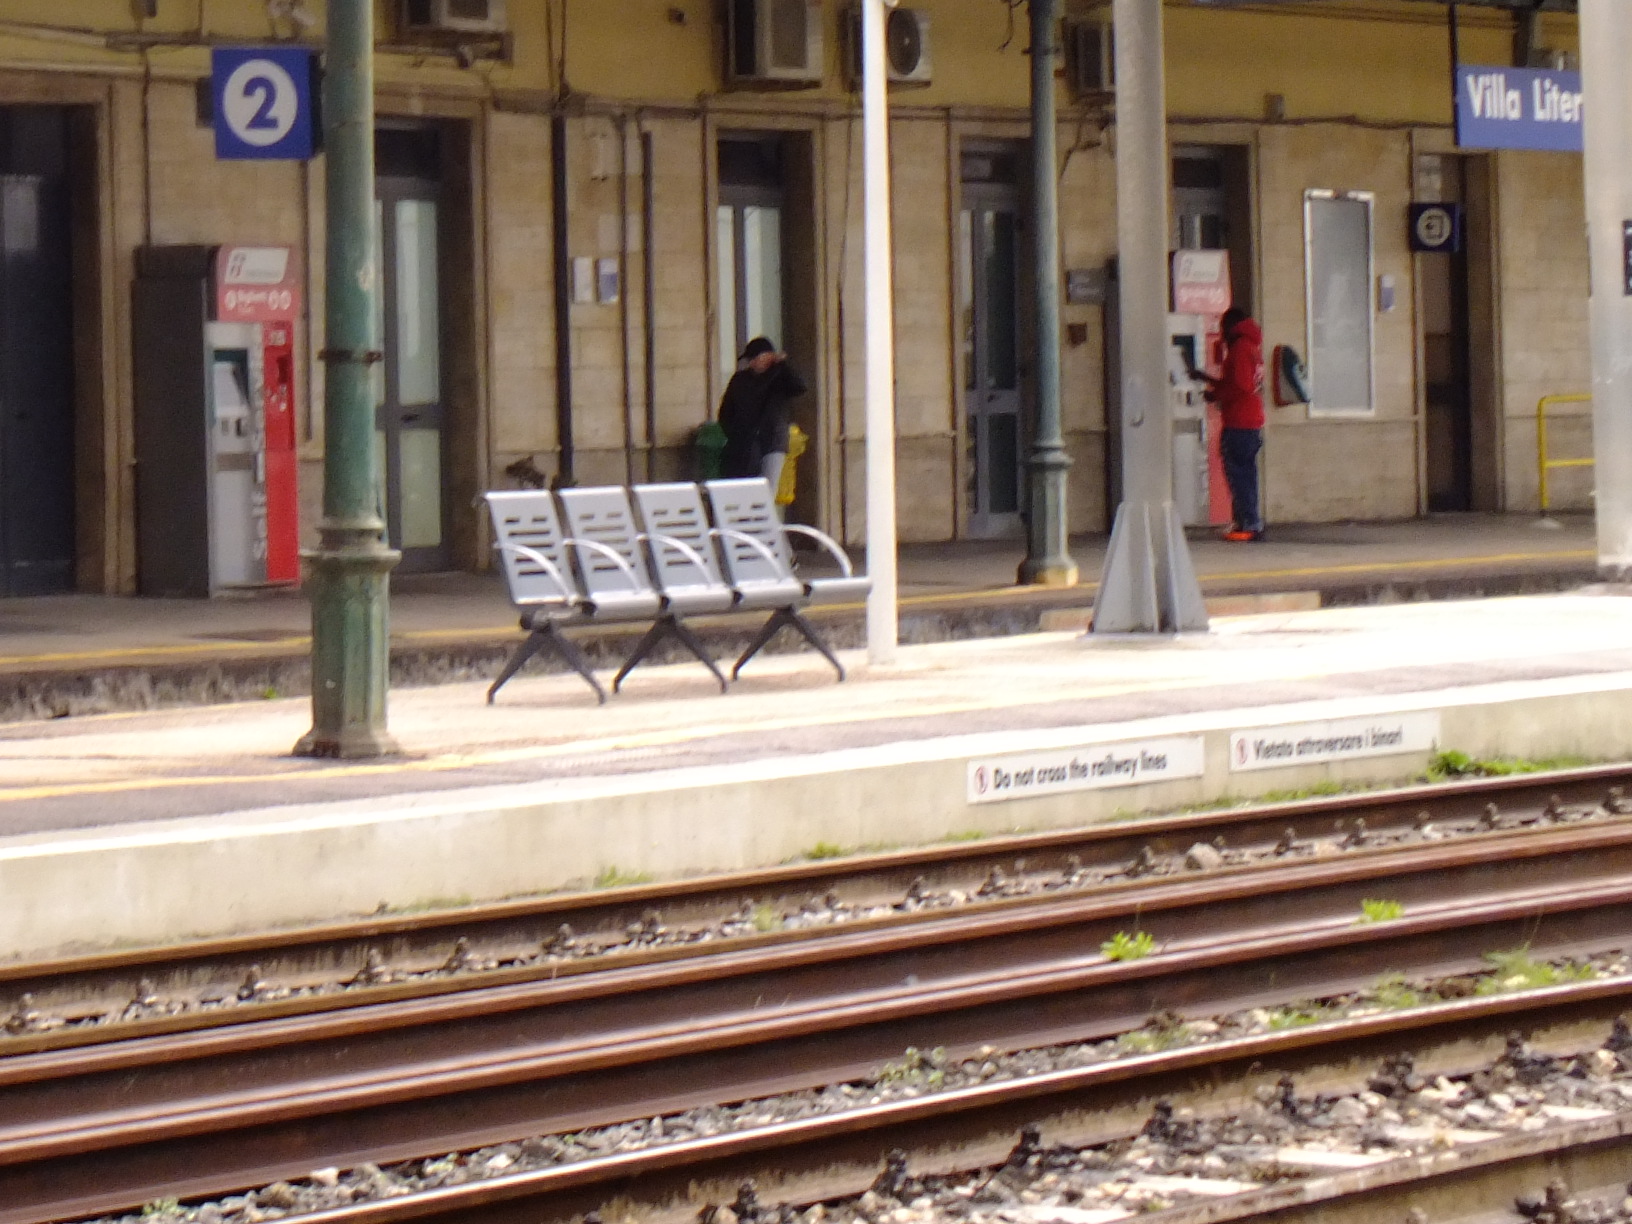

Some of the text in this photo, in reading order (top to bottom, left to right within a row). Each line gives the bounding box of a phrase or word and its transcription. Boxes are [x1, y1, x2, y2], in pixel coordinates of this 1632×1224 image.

[243, 77, 279, 130] 2
[1466, 73, 1521, 120] Villa
[1254, 738, 1294, 760] Vietato
[1296, 733, 1362, 756] attraversare
[1371, 725, 1403, 747] binari
[994, 750, 1167, 790] Do not cross the railway lines
